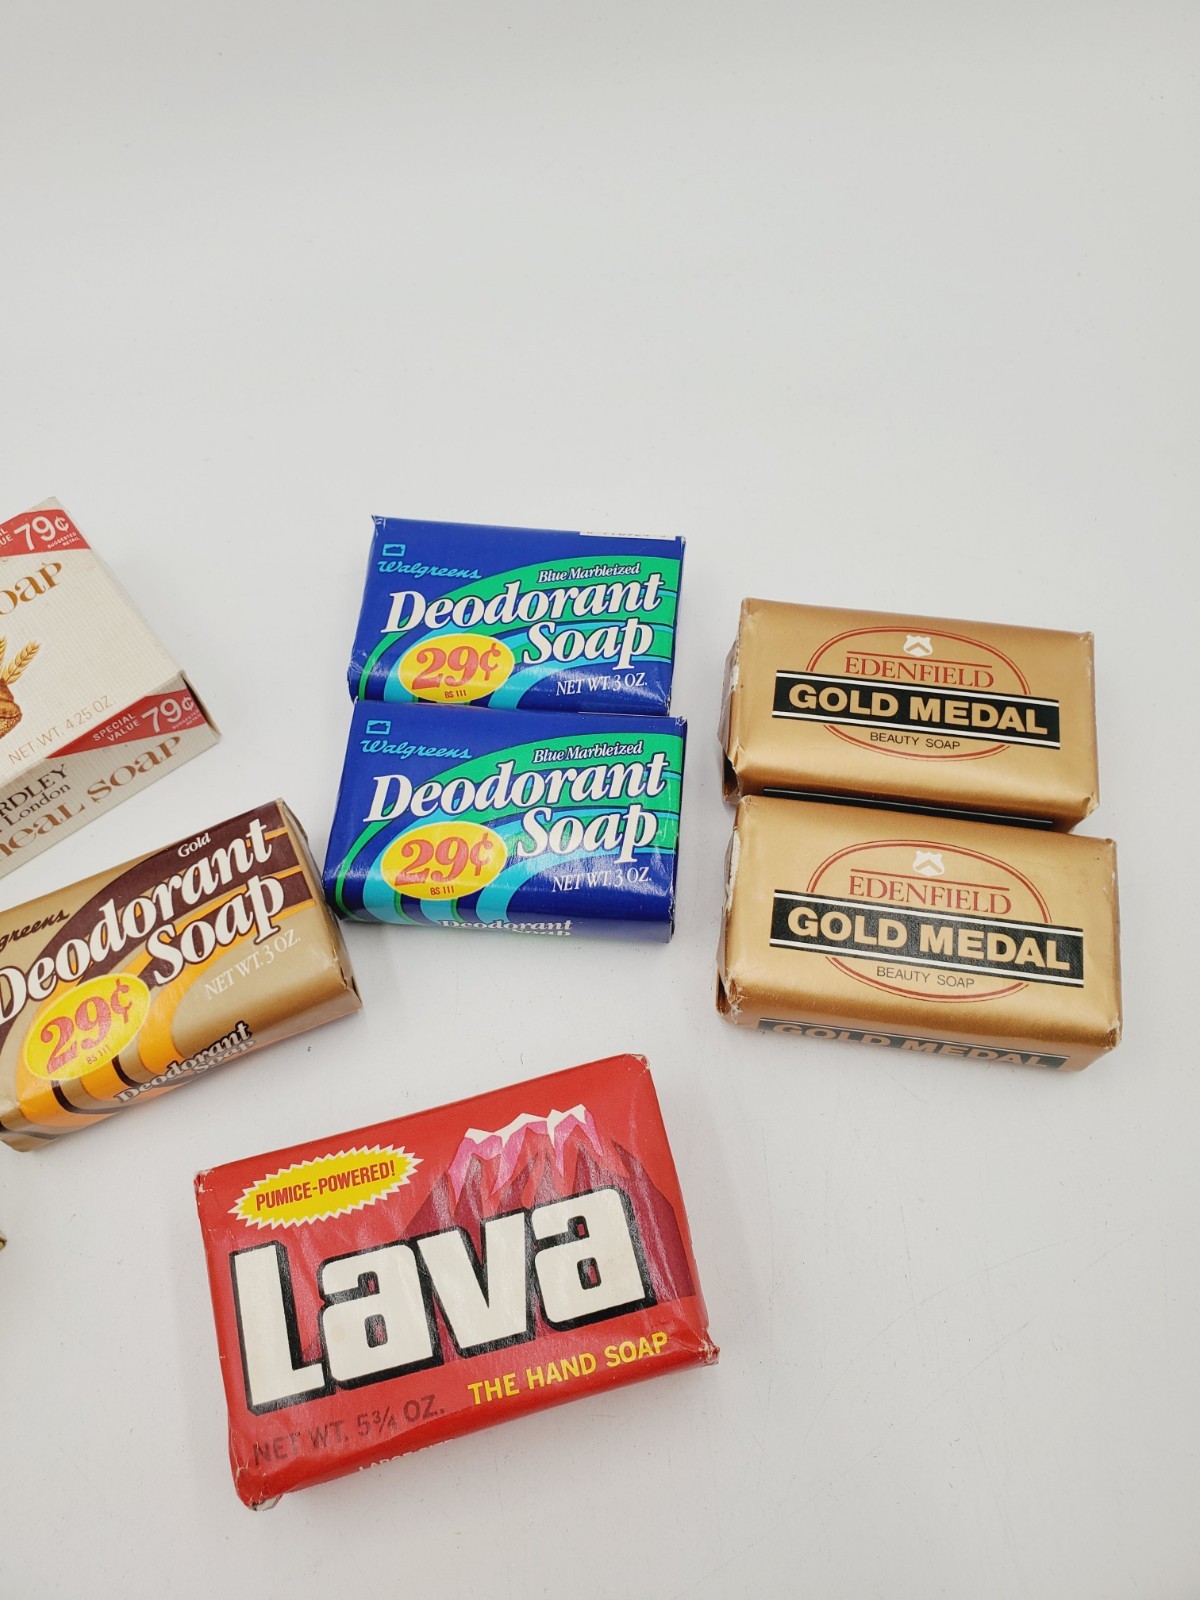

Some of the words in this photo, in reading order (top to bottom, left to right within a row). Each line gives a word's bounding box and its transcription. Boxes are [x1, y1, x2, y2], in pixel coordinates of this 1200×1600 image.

[14, 516, 69, 551] 79¢
[377, 560, 482, 579] Walgreens
[538, 569, 567, 583] Blue
[568, 562, 641, 580] Marbleized
[380, 572, 665, 634] Deodorant
[523, 617, 654, 671] Soap
[411, 642, 501, 691] 29¢
[555, 679, 585, 697] NET
[586, 674, 611, 692] WT.
[612, 673, 622, 691] 3
[624, 671, 648, 689] OZ.
[844, 655, 995, 690] EDENFIELD
[141, 696, 194, 732] 79¢
[444, 690, 454, 699] BS
[788, 684, 899, 718] GOLD
[908, 696, 1048, 735] MEDAL
[8, 740, 36, 765] NET
[65, 707, 93, 730] 4.25
[93, 712, 137, 741] SPECIAL
[107, 719, 141, 742] VALUE
[869, 731, 920, 747] BEAUTY
[925, 738, 961, 751] SOAP
[360, 739, 472, 760] Walgreens
[533, 747, 564, 762] Blue
[565, 741, 643, 761] Marbleized
[3, 784, 71, 826] London
[362, 753, 669, 823] Deodorant
[177, 832, 211, 859] Gold
[517, 804, 658, 864] Soap
[394, 832, 494, 888] 29¢
[552, 874, 584, 893] NET
[586, 869, 612, 887] WT.
[613, 868, 624, 888] 3
[626, 866, 652, 883] OZ.
[429, 886, 441, 896] BS
[848, 874, 1012, 916] EDENFIELD
[0, 818, 272, 1025] Deodorant
[146, 874, 285, 987] Soap
[439, 919, 573, 930] Deodorant
[787, 906, 908, 949] GOLD
[919, 923, 1071, 971] MEDAL
[203, 971, 235, 1000] NET
[263, 945, 276, 966] 3
[275, 928, 302, 954] OZ.
[876, 965, 931, 984] BEAUTY
[937, 974, 975, 991] SOAP
[40, 978, 132, 1076] 29¢
[772, 1024, 890, 1047] GOLD
[899, 1039, 1050, 1068] MEDAL
[86, 1053, 97, 1064] BS
[114, 1020, 253, 1103] Deodorant
[255, 1159, 396, 1212] PUMICE-POWERED!
[231, 1187, 654, 1414] Lava
[467, 1373, 520, 1406] THE
[526, 1348, 597, 1395] HAND
[606, 1332, 668, 1369] SOAP
[252, 1434, 300, 1466] NET
[310, 1419, 350, 1447] WT.
[403, 1393, 446, 1421] OZ.
